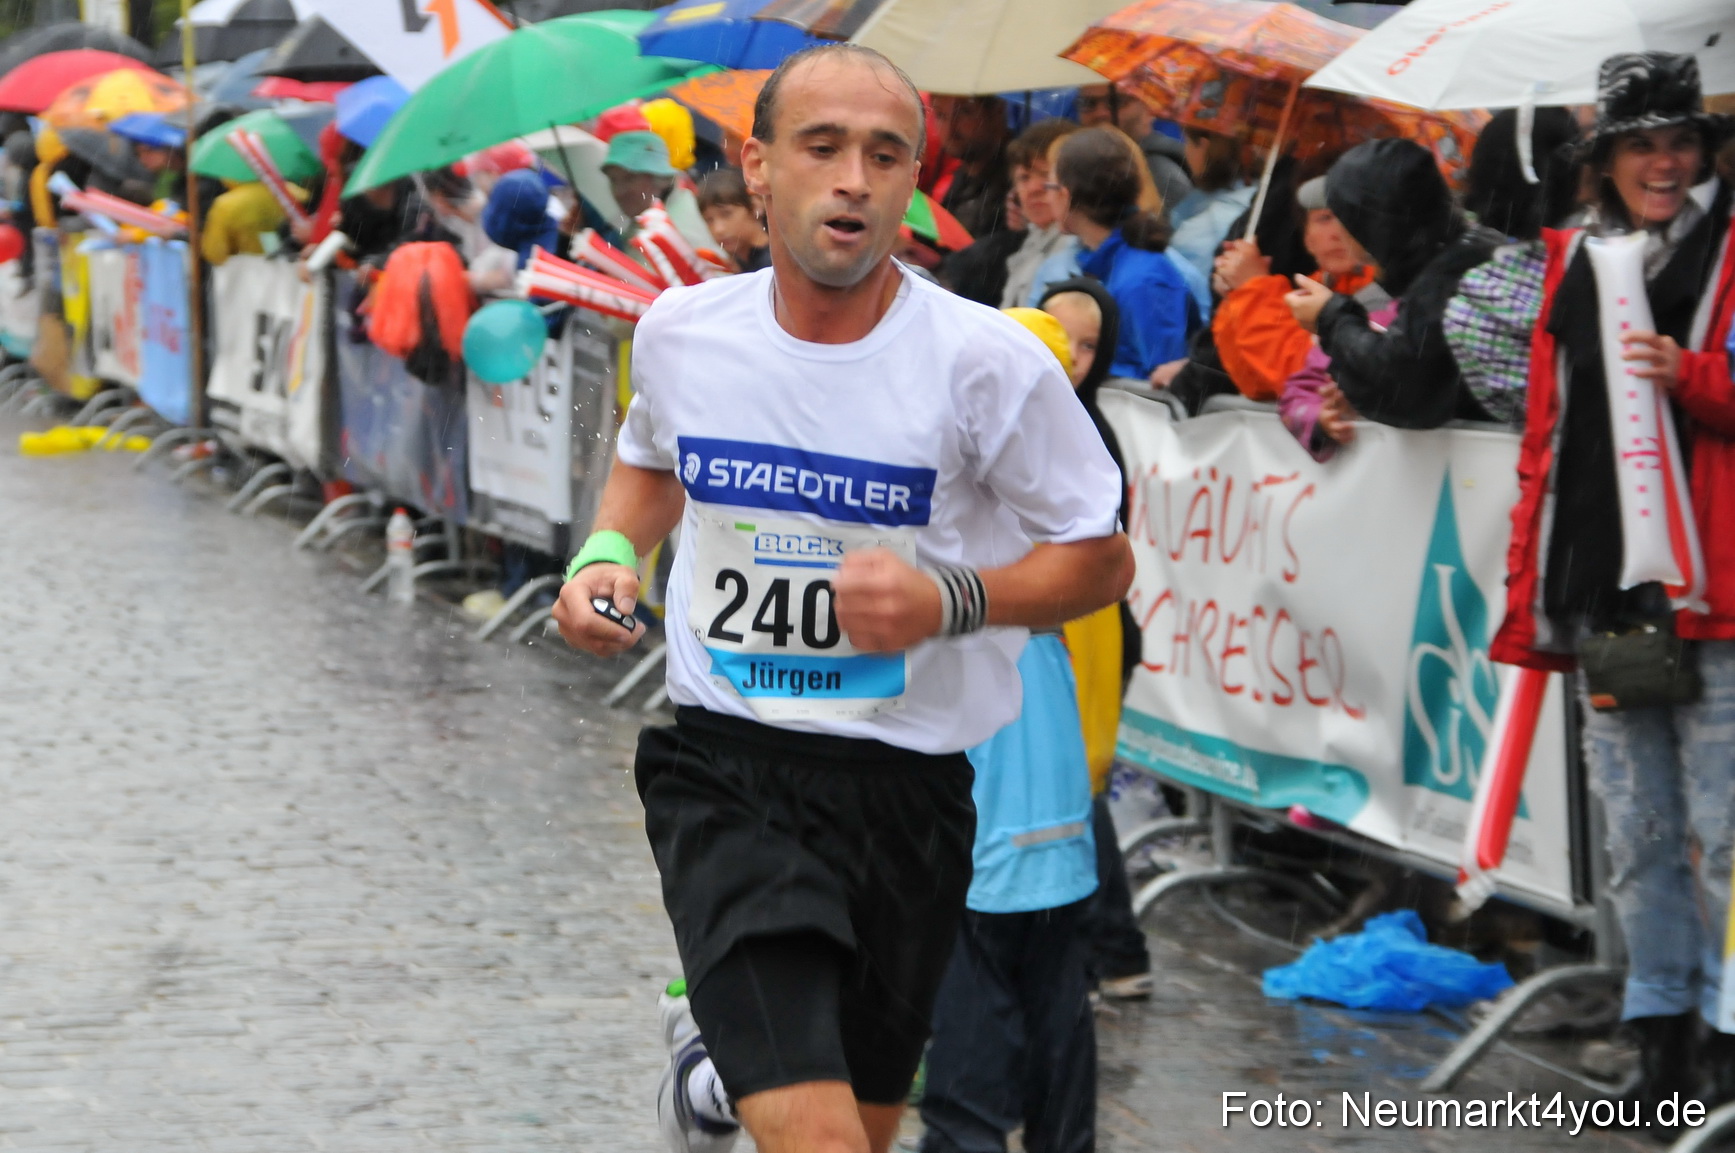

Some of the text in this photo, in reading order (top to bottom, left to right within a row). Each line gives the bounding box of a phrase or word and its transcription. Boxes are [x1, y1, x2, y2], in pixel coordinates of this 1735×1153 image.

[708, 457, 912, 513] STAEDTLER
[754, 532, 844, 556] BOCK
[742, 661, 842, 696] Jürgen
